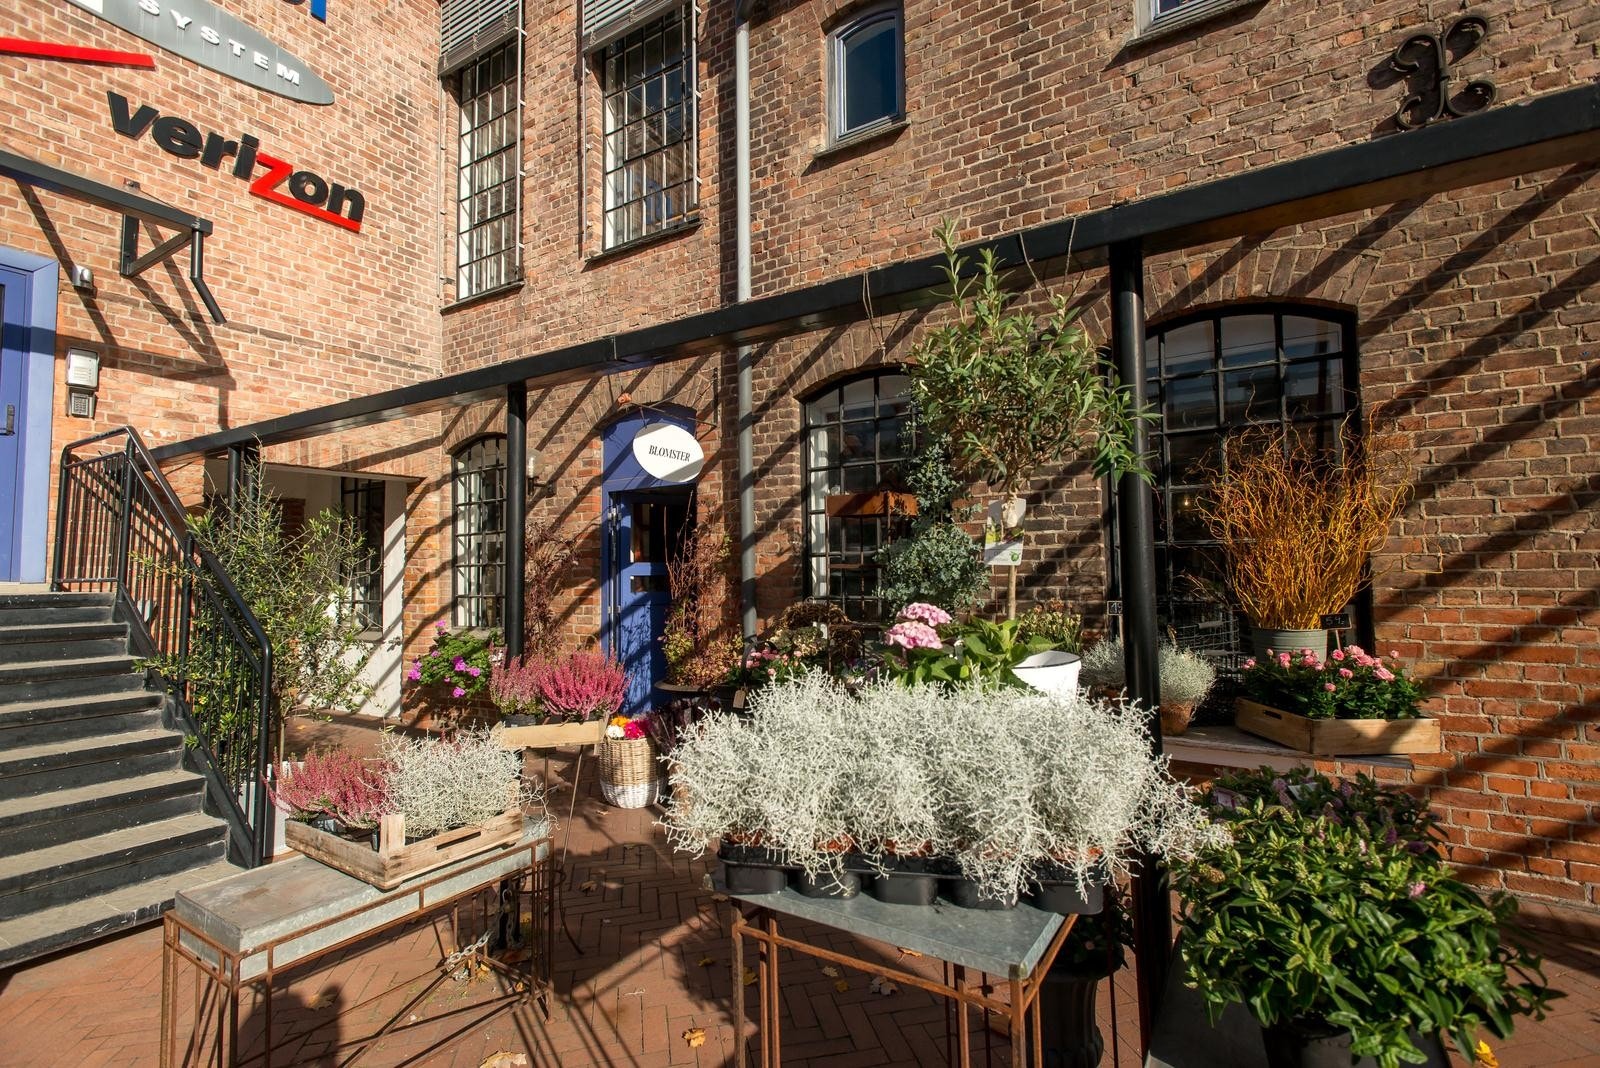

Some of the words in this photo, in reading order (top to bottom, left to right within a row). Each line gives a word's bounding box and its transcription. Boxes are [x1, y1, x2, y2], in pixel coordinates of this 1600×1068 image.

[139, 0, 300, 85] SYSTEM
[107, 91, 365, 232] verizon
[649, 445, 691, 462] BLOMSTER
